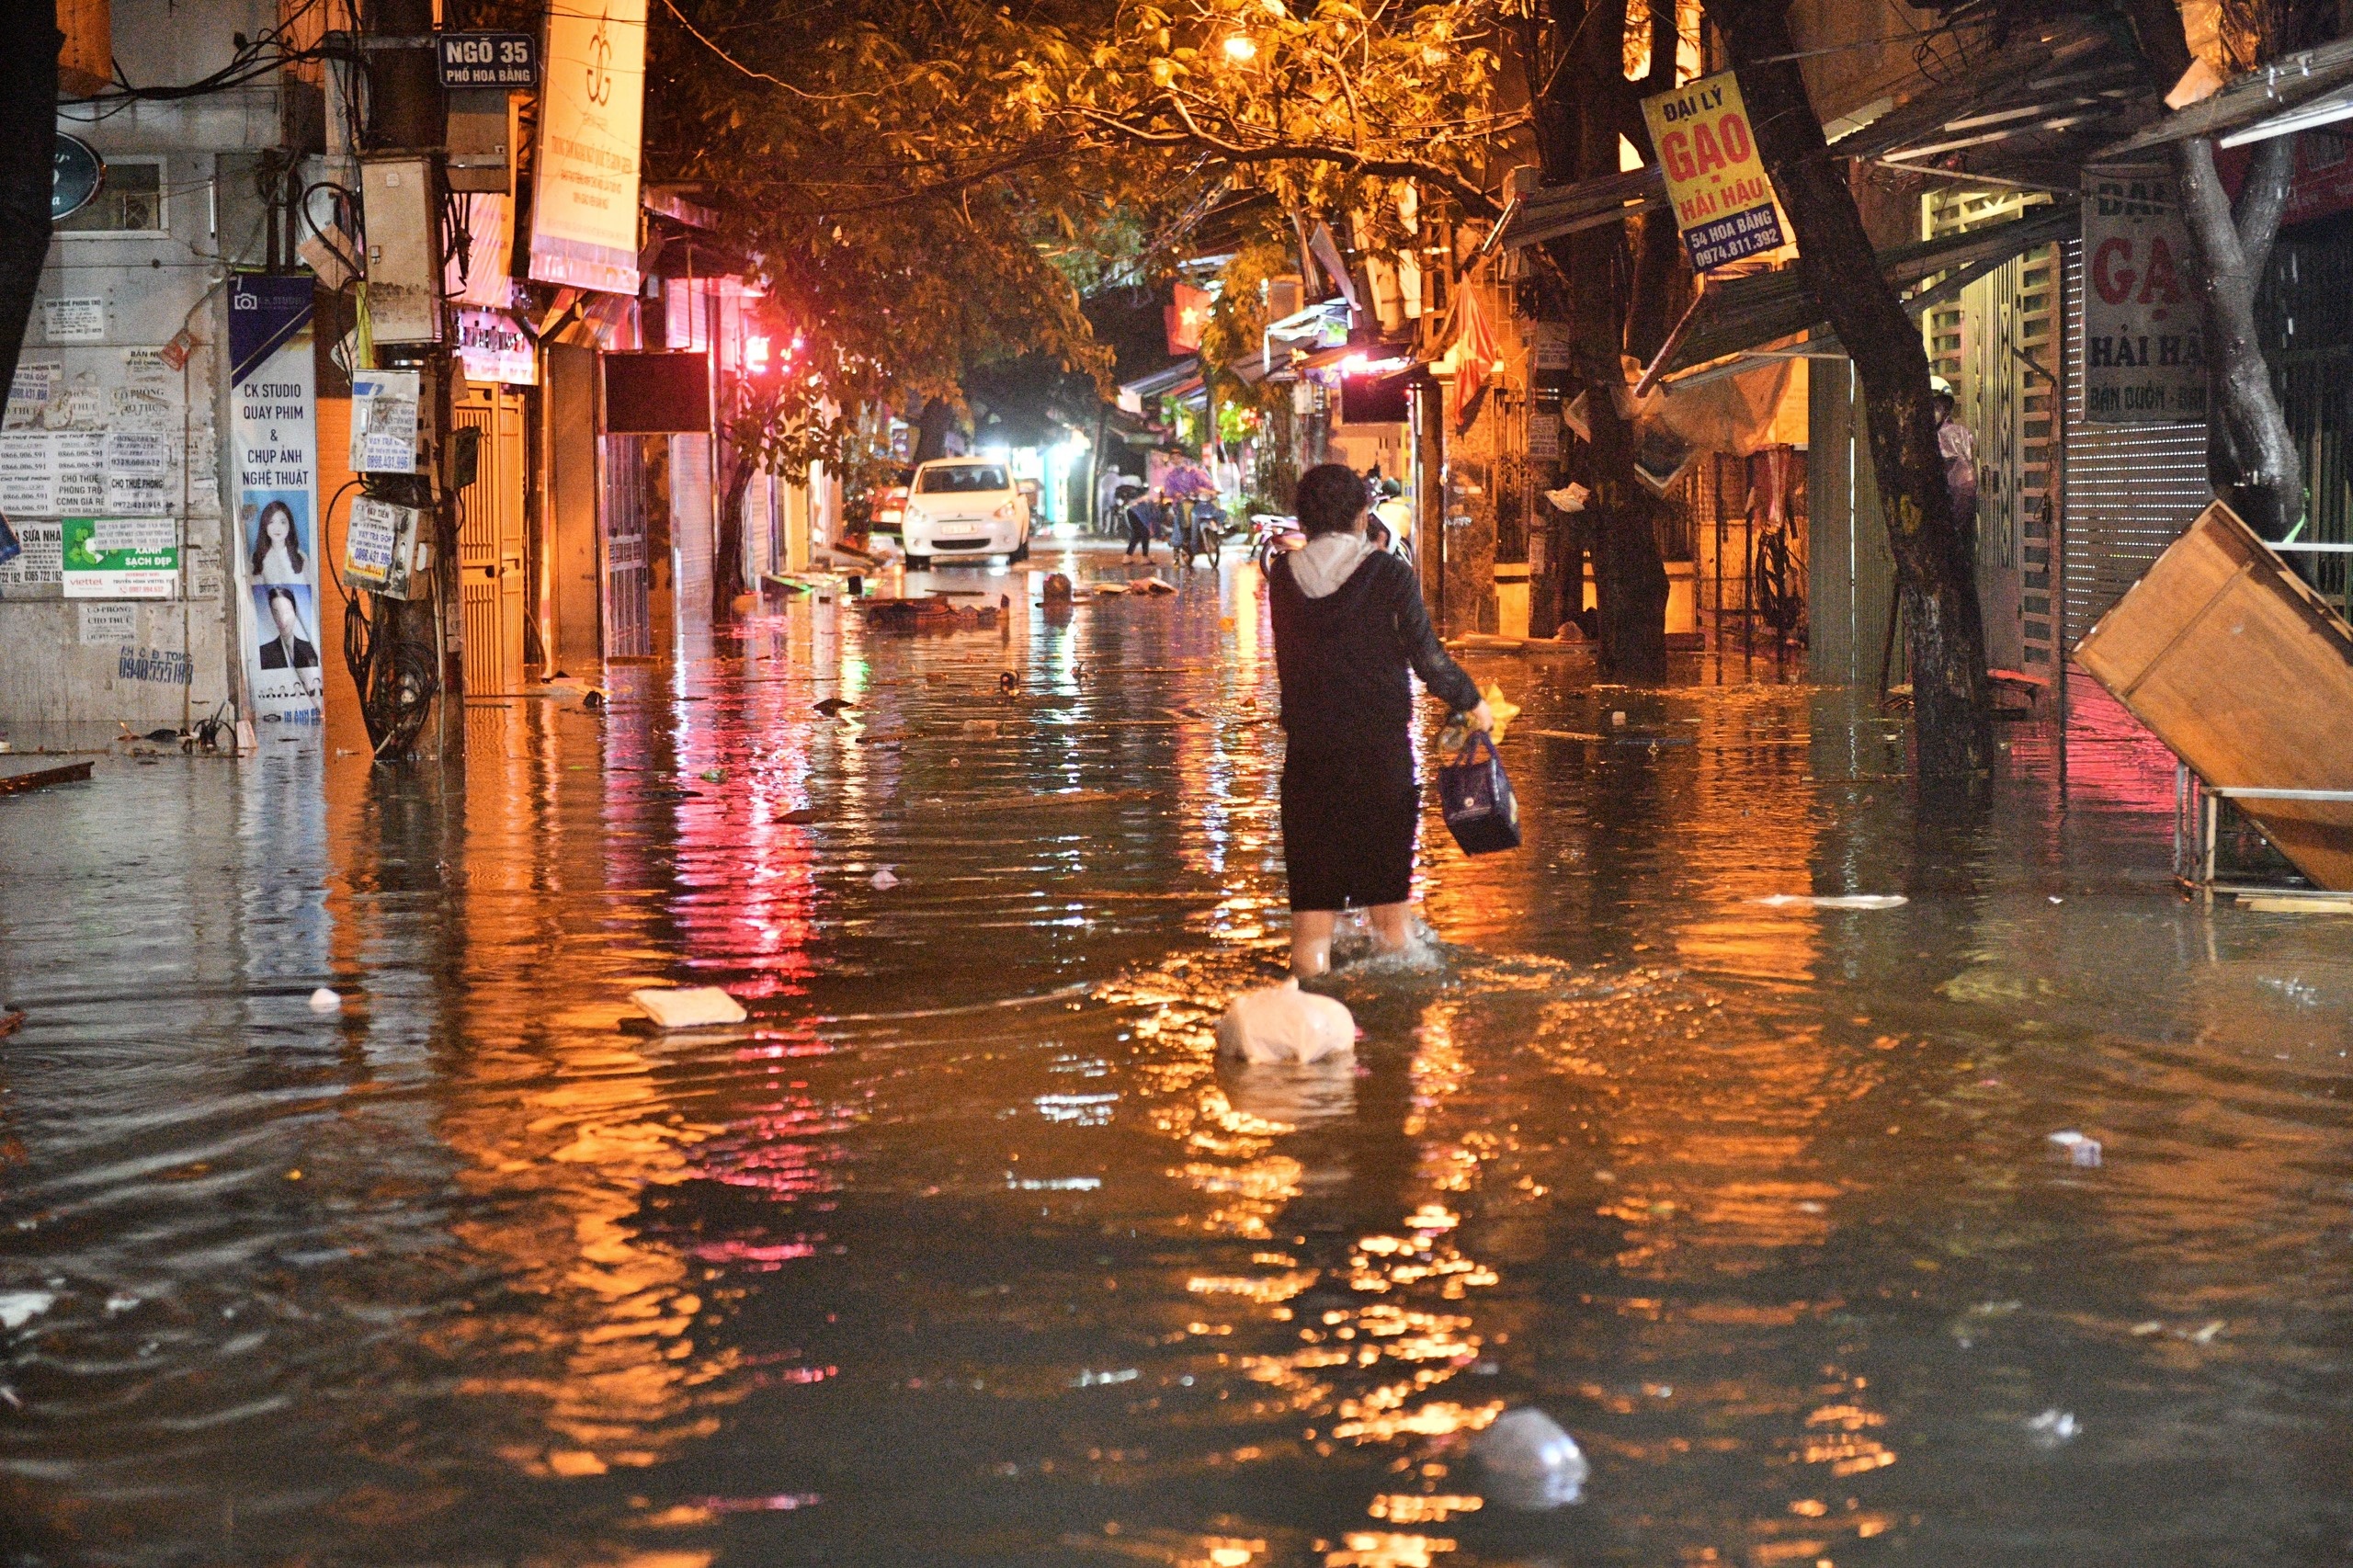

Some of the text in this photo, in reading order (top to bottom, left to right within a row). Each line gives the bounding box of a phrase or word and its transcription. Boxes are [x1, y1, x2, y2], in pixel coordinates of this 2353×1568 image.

[447, 38, 529, 63] NGÕ 35
[447, 66, 530, 84] PHỐ HOA BẰNG
[1663, 84, 1723, 123] ĐẠI LÝ
[1661, 112, 1752, 184] GẠO
[1678, 176, 1765, 222] HẢI HẬU
[1690, 210, 1773, 249] 54 HOA BẰNG
[1695, 227, 1779, 267] 0974.811.392
[2090, 323, 2150, 368] HẢI
[244, 383, 301, 398] CK STUDIO
[244, 405, 303, 420] QUAY PHIM
[270, 428, 278, 441] &
[248, 445, 302, 466] CHỤP ẢNH
[62, 474, 77, 483] CHO
[111, 478, 124, 489] CHO
[125, 477, 142, 489] THUÊ
[242, 469, 309, 488] NGHỆ THUẬT
[56, 497, 79, 506] CCMN
[23, 525, 62, 542] SỬA NHÀ
[125, 557, 173, 568] SẠCH ĐẸP
[11, 572, 21, 584] 162
[40, 571, 51, 582] 722
[52, 571, 63, 582] 162
[69, 577, 104, 586] viettel
